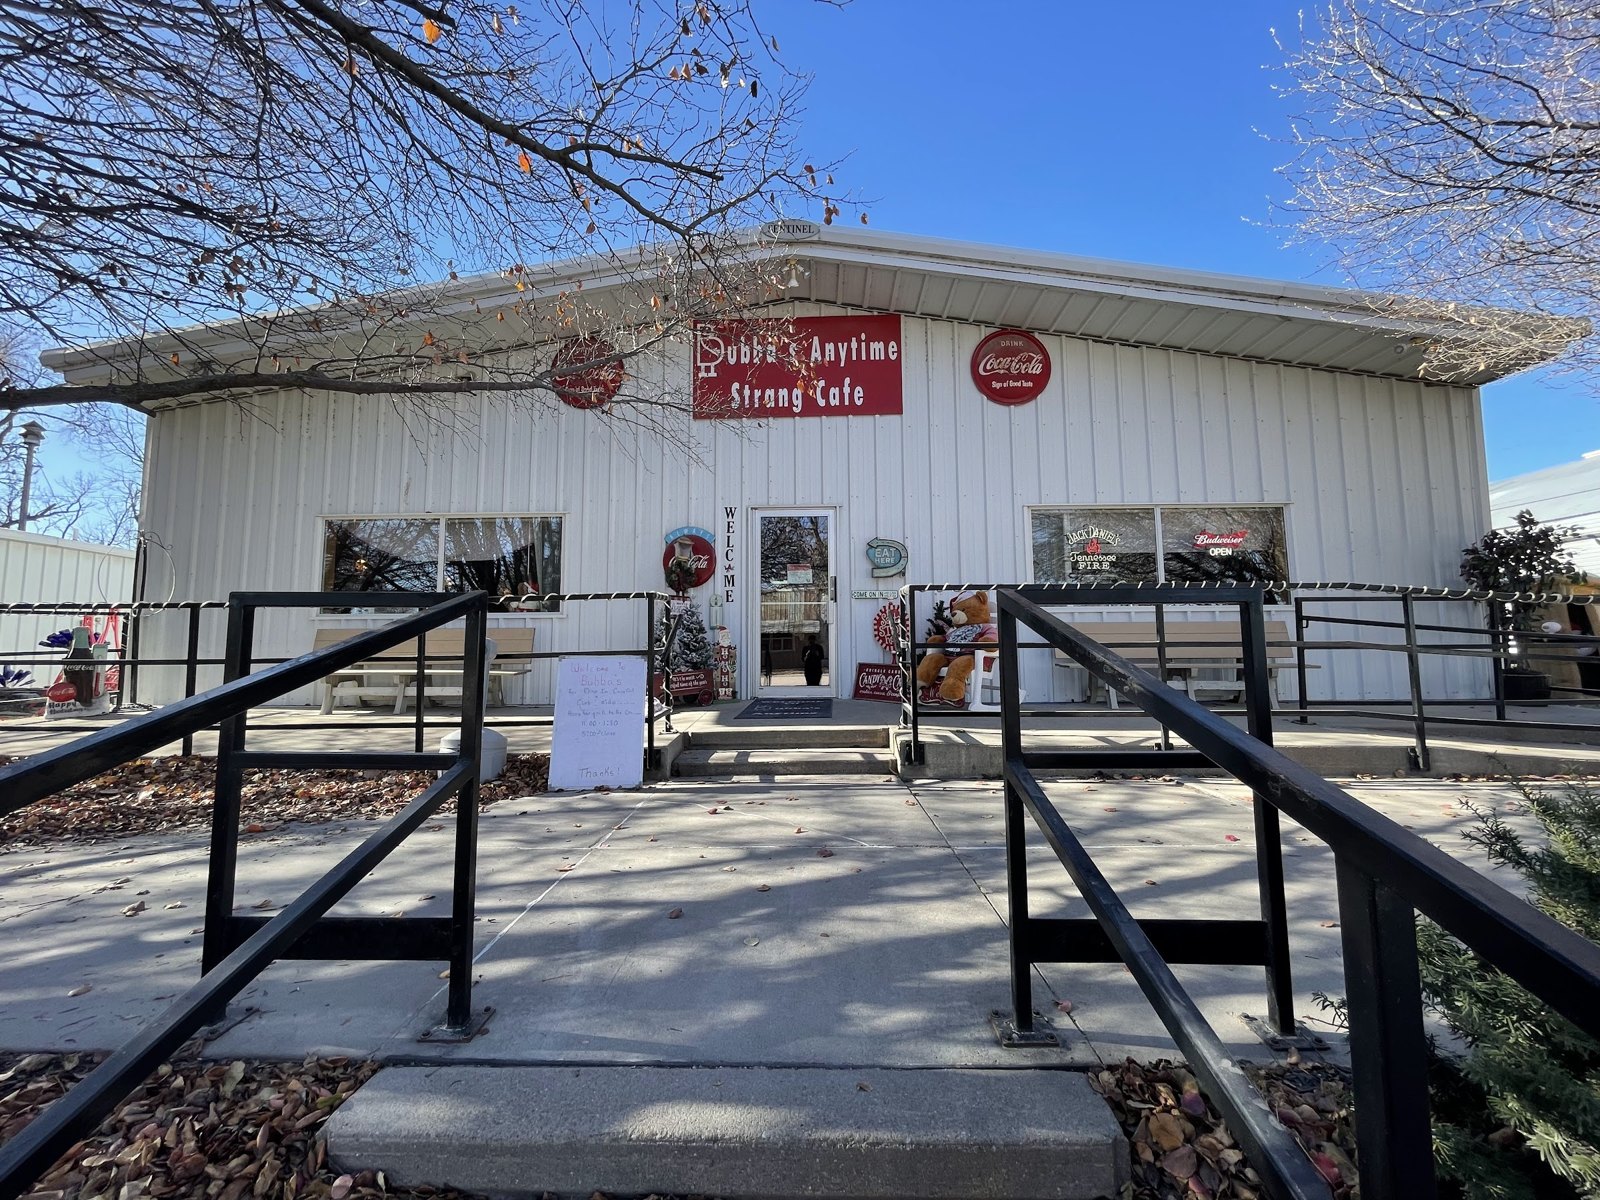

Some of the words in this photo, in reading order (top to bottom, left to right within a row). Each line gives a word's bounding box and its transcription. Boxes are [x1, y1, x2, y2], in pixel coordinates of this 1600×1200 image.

[767, 224, 814, 234] SENTINEL
[697, 324, 800, 378] Bubbas
[810, 333, 898, 367] Anytime
[978, 352, 1043, 376] Coca-Cola
[730, 382, 803, 413] Strang
[815, 377, 864, 408] Cafe
[1066, 529, 1089, 545] JACK
[1194, 535, 1244, 545] Budweiser
[875, 548, 896, 558] EAT
[1069, 551, 1117, 562] Tennessee
[1209, 547, 1233, 556] OPEN
[1078, 561, 1111, 570] FIRE
